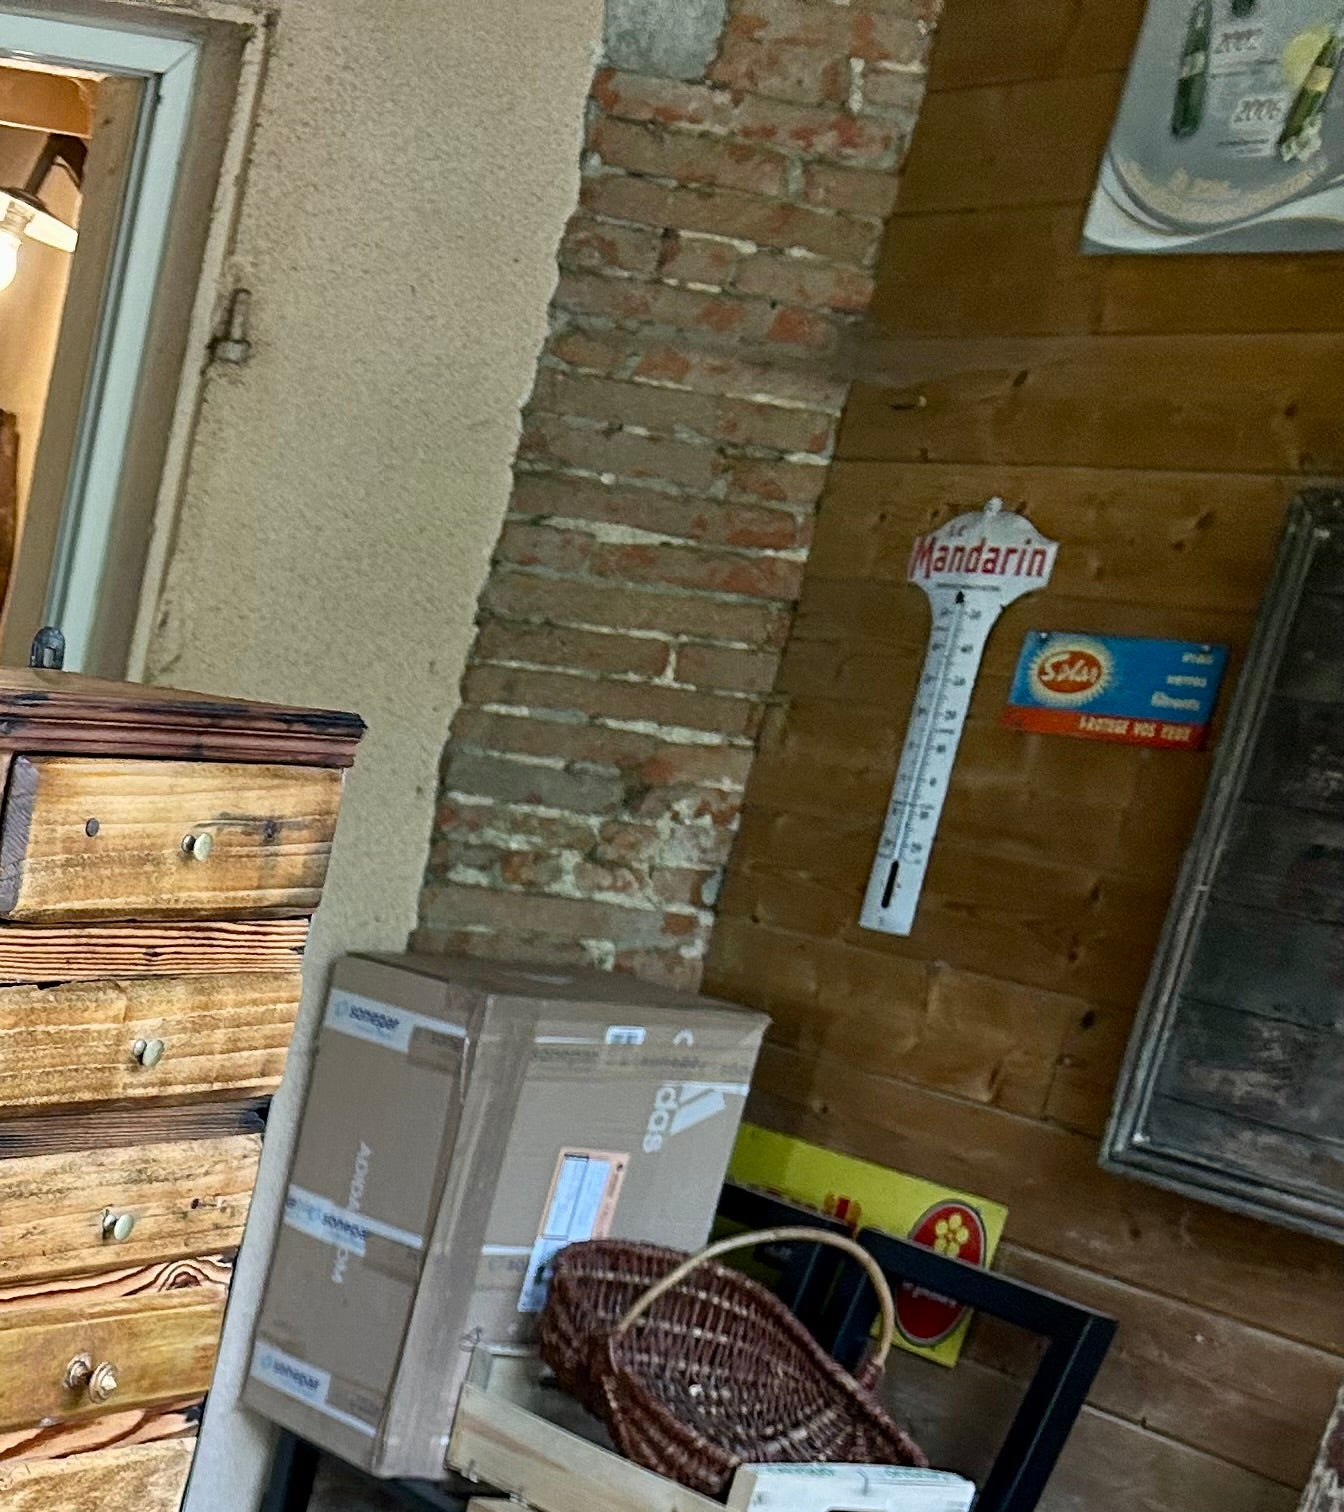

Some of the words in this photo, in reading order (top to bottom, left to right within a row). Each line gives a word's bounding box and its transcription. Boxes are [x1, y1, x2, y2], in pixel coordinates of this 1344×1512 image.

[909, 536, 1048, 579] Mandarin
[321, 1212, 369, 1240] sonepa
[272, 1360, 321, 1390] sonepar
